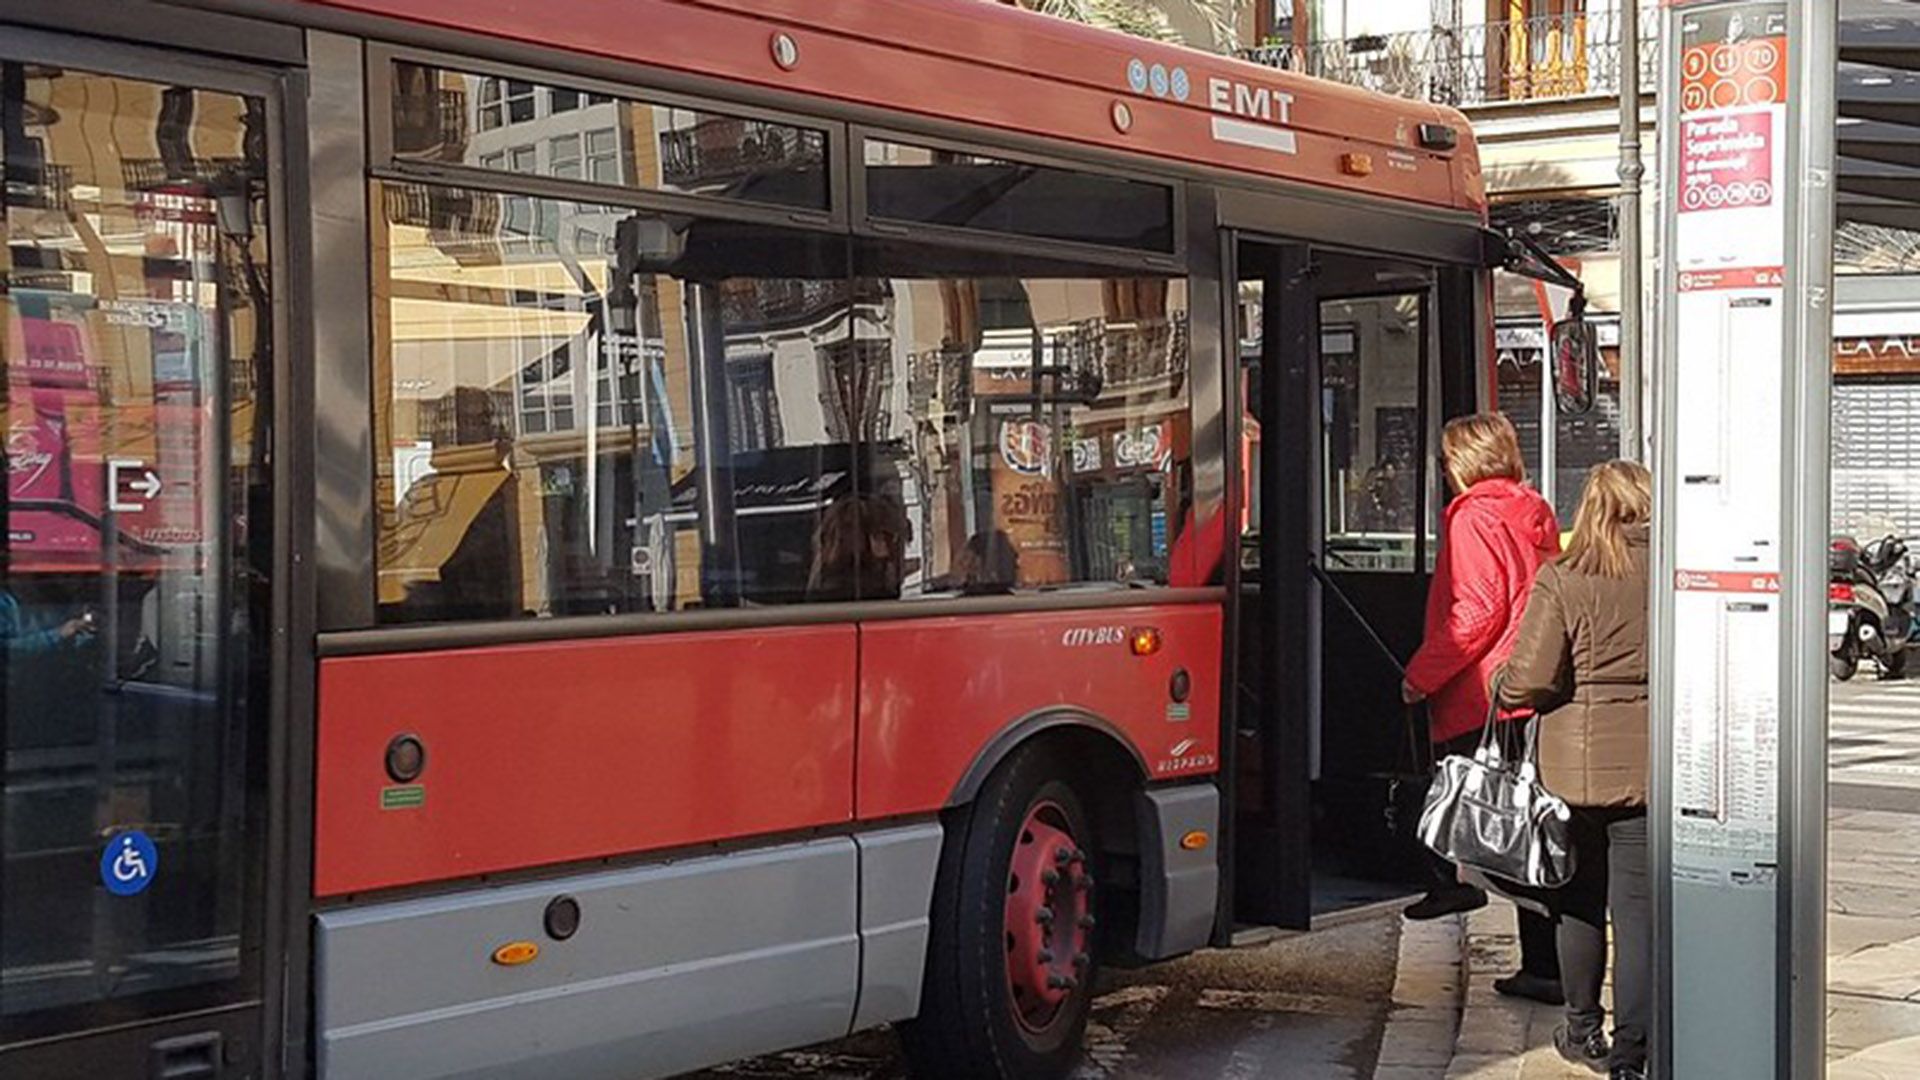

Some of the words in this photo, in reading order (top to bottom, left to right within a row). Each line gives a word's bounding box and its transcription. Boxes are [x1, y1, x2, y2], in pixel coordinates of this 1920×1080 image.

[1689, 55, 1700, 74] 9
[1209, 77, 1294, 125] EMT
[1062, 626, 1126, 647] CITYBUS
